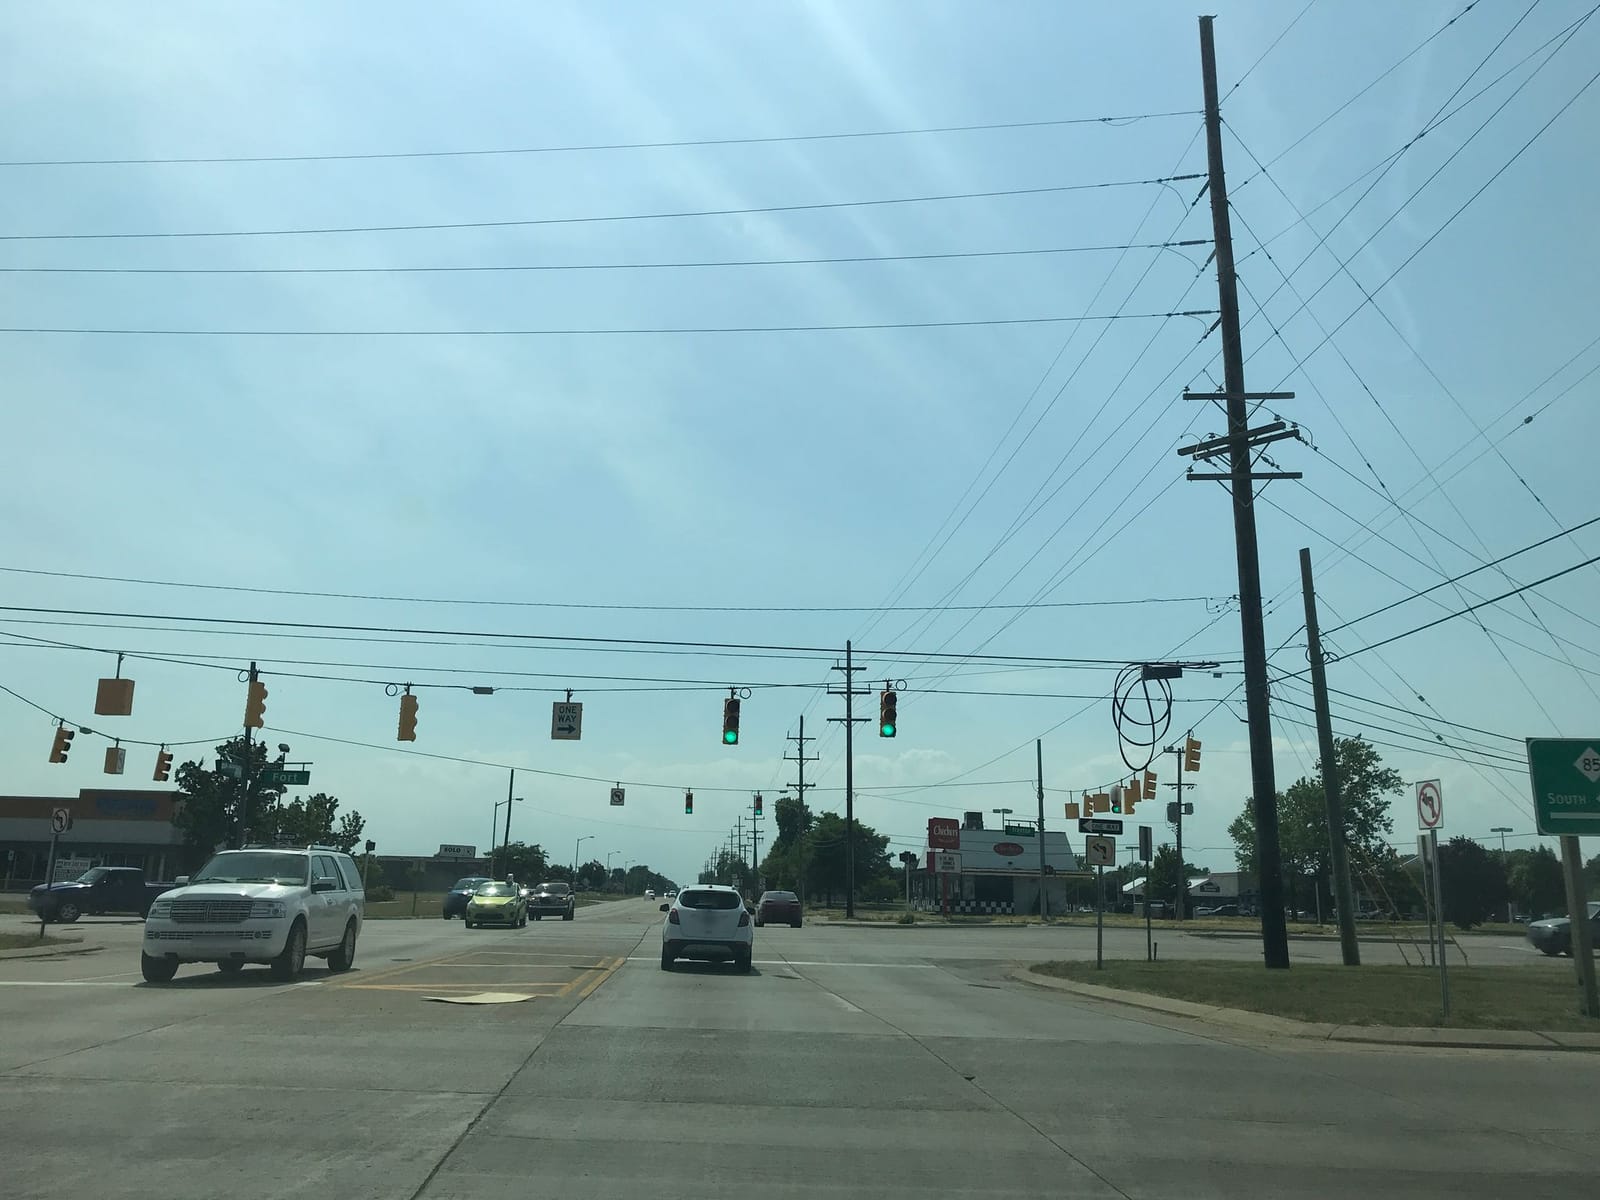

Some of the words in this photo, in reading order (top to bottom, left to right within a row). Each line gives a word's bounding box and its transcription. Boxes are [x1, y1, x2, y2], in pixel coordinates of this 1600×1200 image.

[559, 705, 577, 714] ONE
[558, 714, 577, 723] WAY
[1583, 758, 1600, 772] 85
[272, 773, 298, 782] Fort
[1547, 792, 1586, 805] SOUTH
